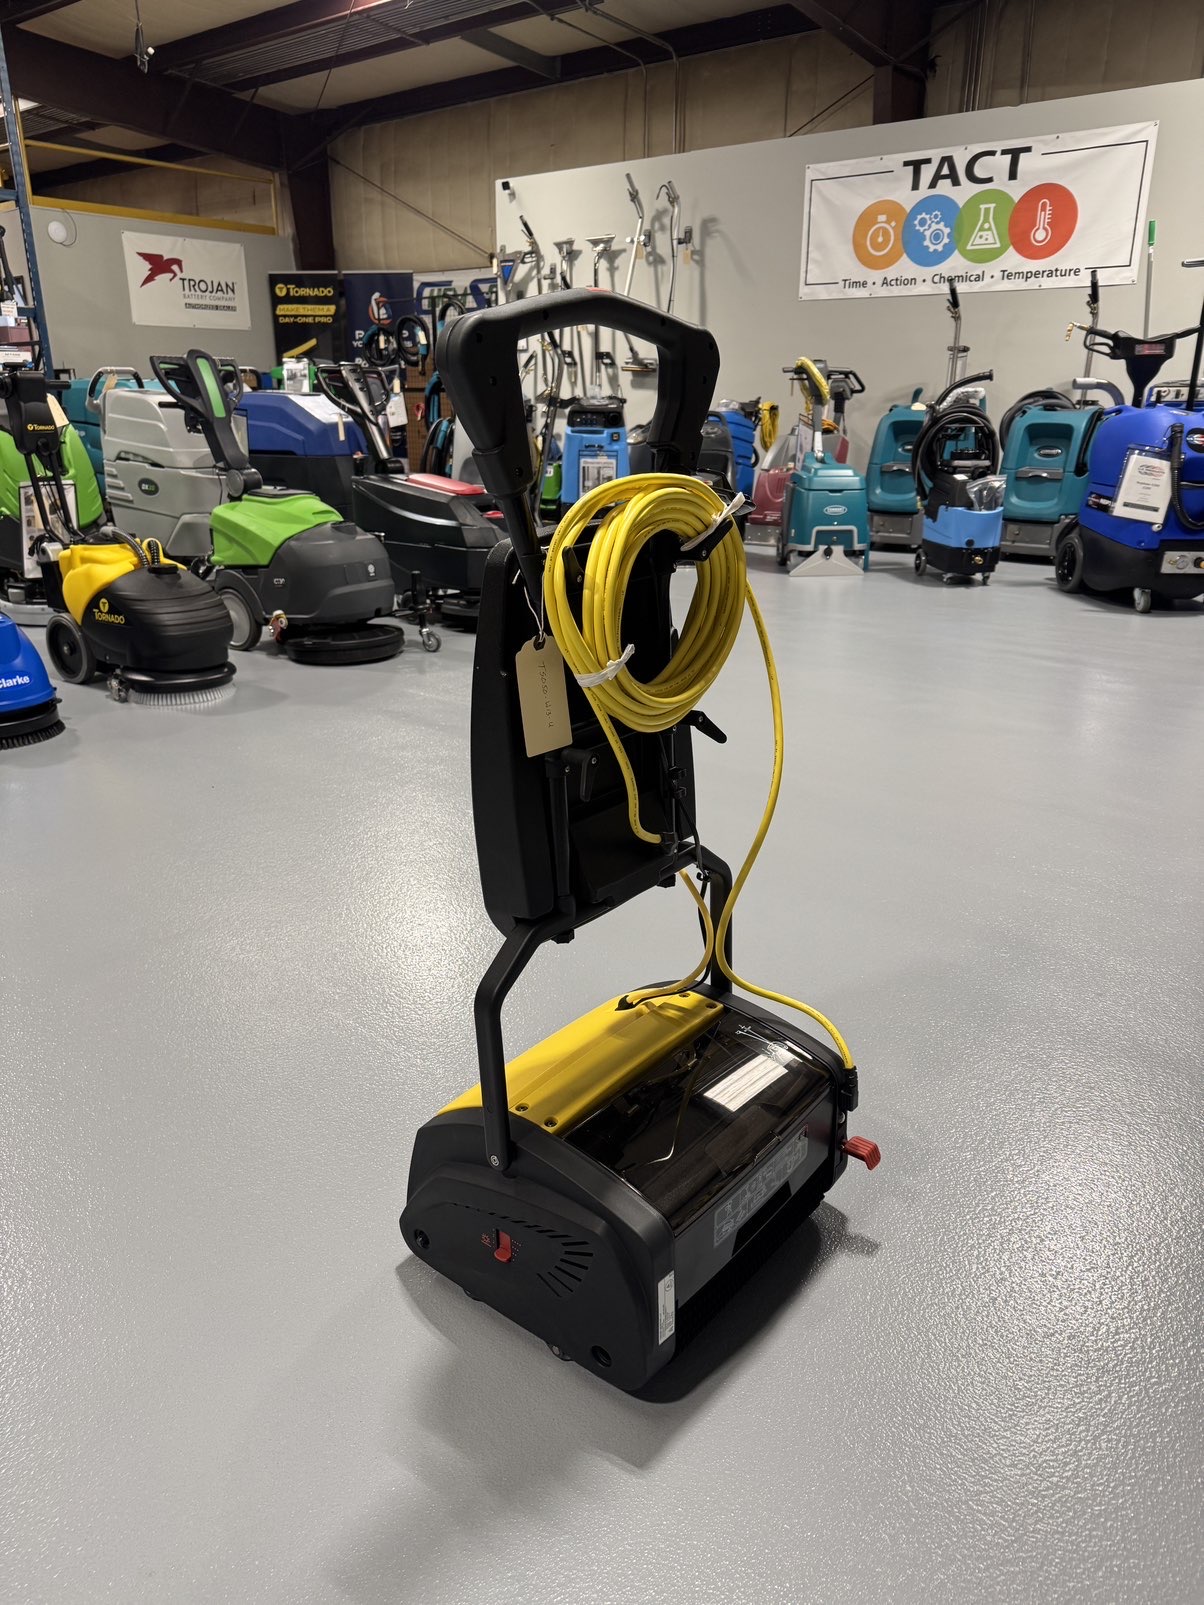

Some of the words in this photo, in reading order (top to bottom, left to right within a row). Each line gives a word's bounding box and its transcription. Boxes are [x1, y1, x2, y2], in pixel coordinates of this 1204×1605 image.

[902, 146, 1033, 192] TACT
[842, 278, 868, 290] Time
[881, 276, 917, 287] Action
[931, 270, 985, 285] Chemical
[1000, 266, 1082, 284] Temperature
[179, 278, 236, 295] TROJAN
[286, 284, 334, 296] TORNADO
[93, 608, 126, 624] TORNADO
[0, 675, 30, 689] larke
